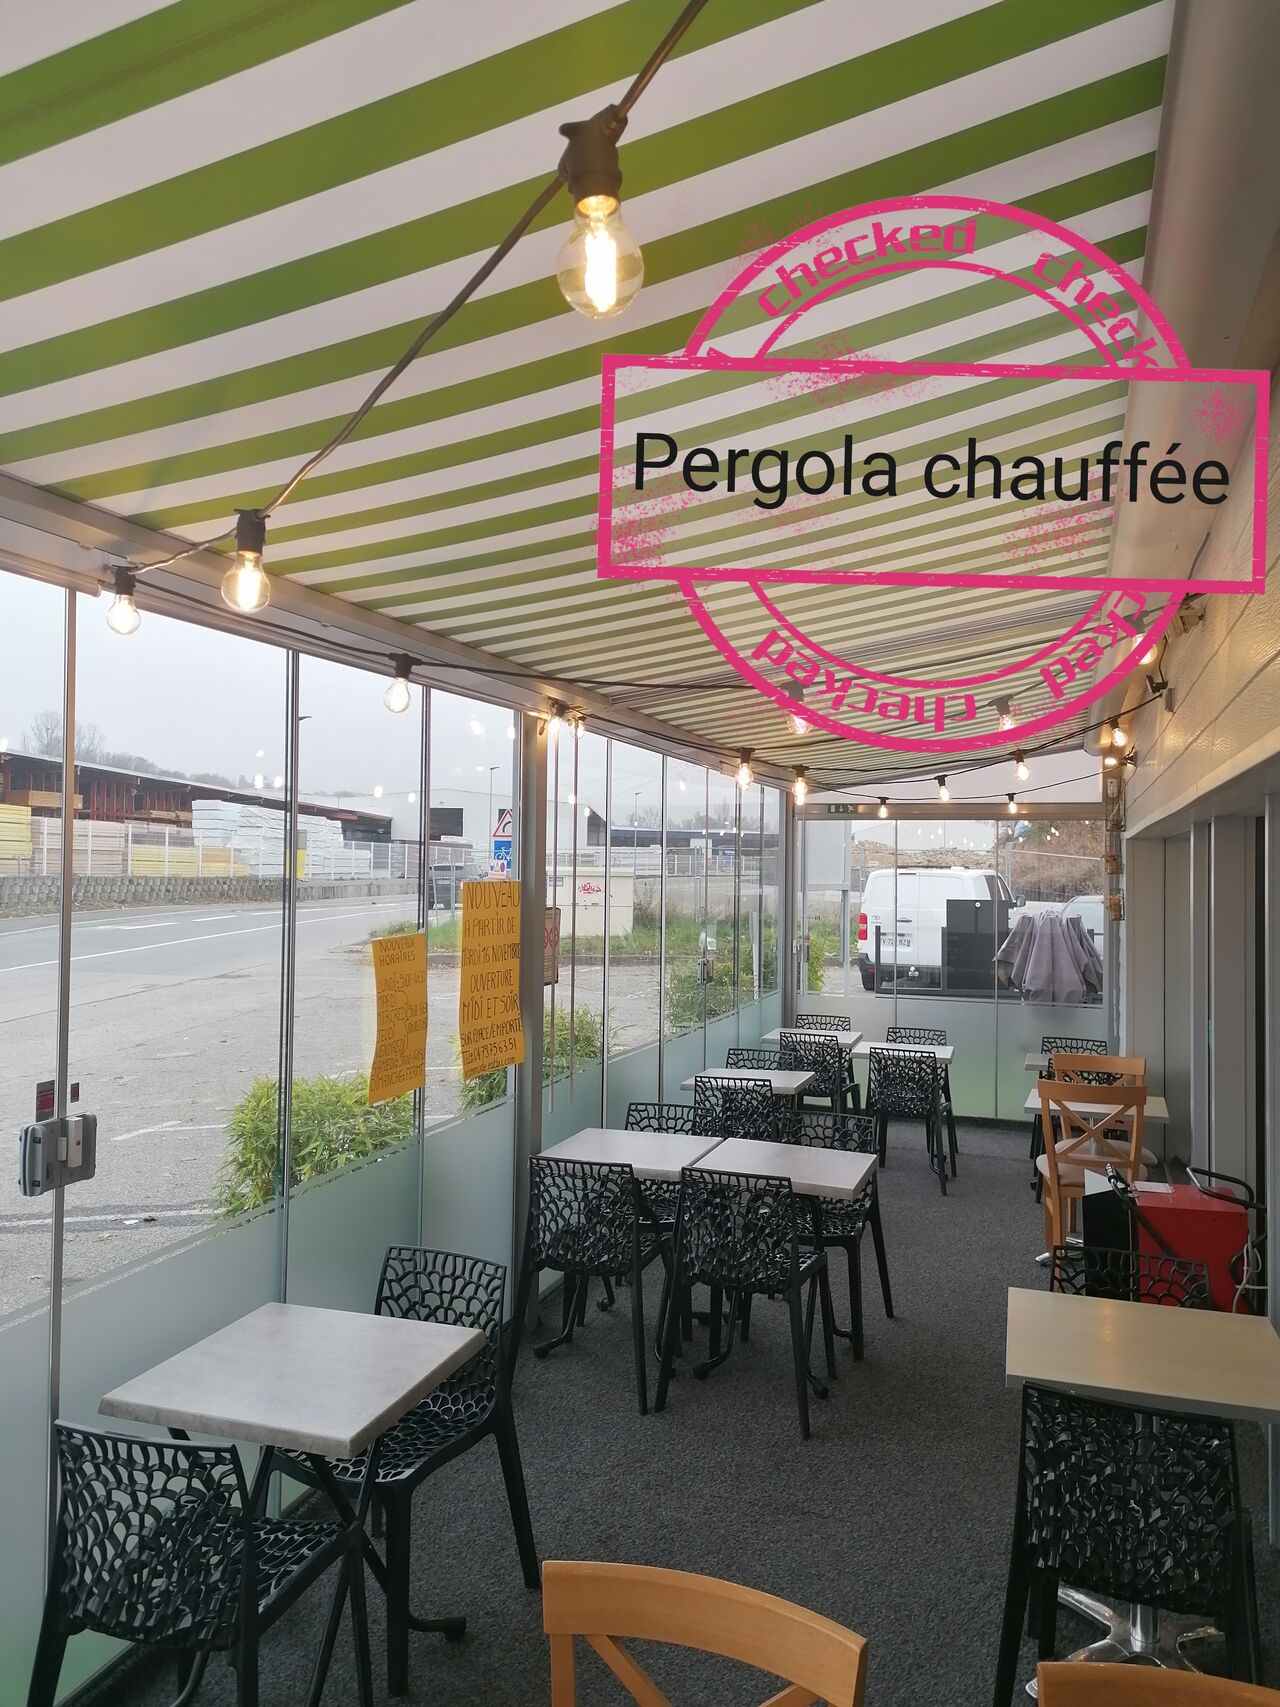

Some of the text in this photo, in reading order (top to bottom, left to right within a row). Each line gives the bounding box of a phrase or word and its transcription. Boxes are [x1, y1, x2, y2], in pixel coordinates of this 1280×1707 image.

[467, 881, 521, 910] NOUVEAU
[464, 919, 471, 939] A
[506, 916, 518, 934] DE
[470, 969, 515, 993] OUVERTURE
[486, 996, 499, 1019] ET
